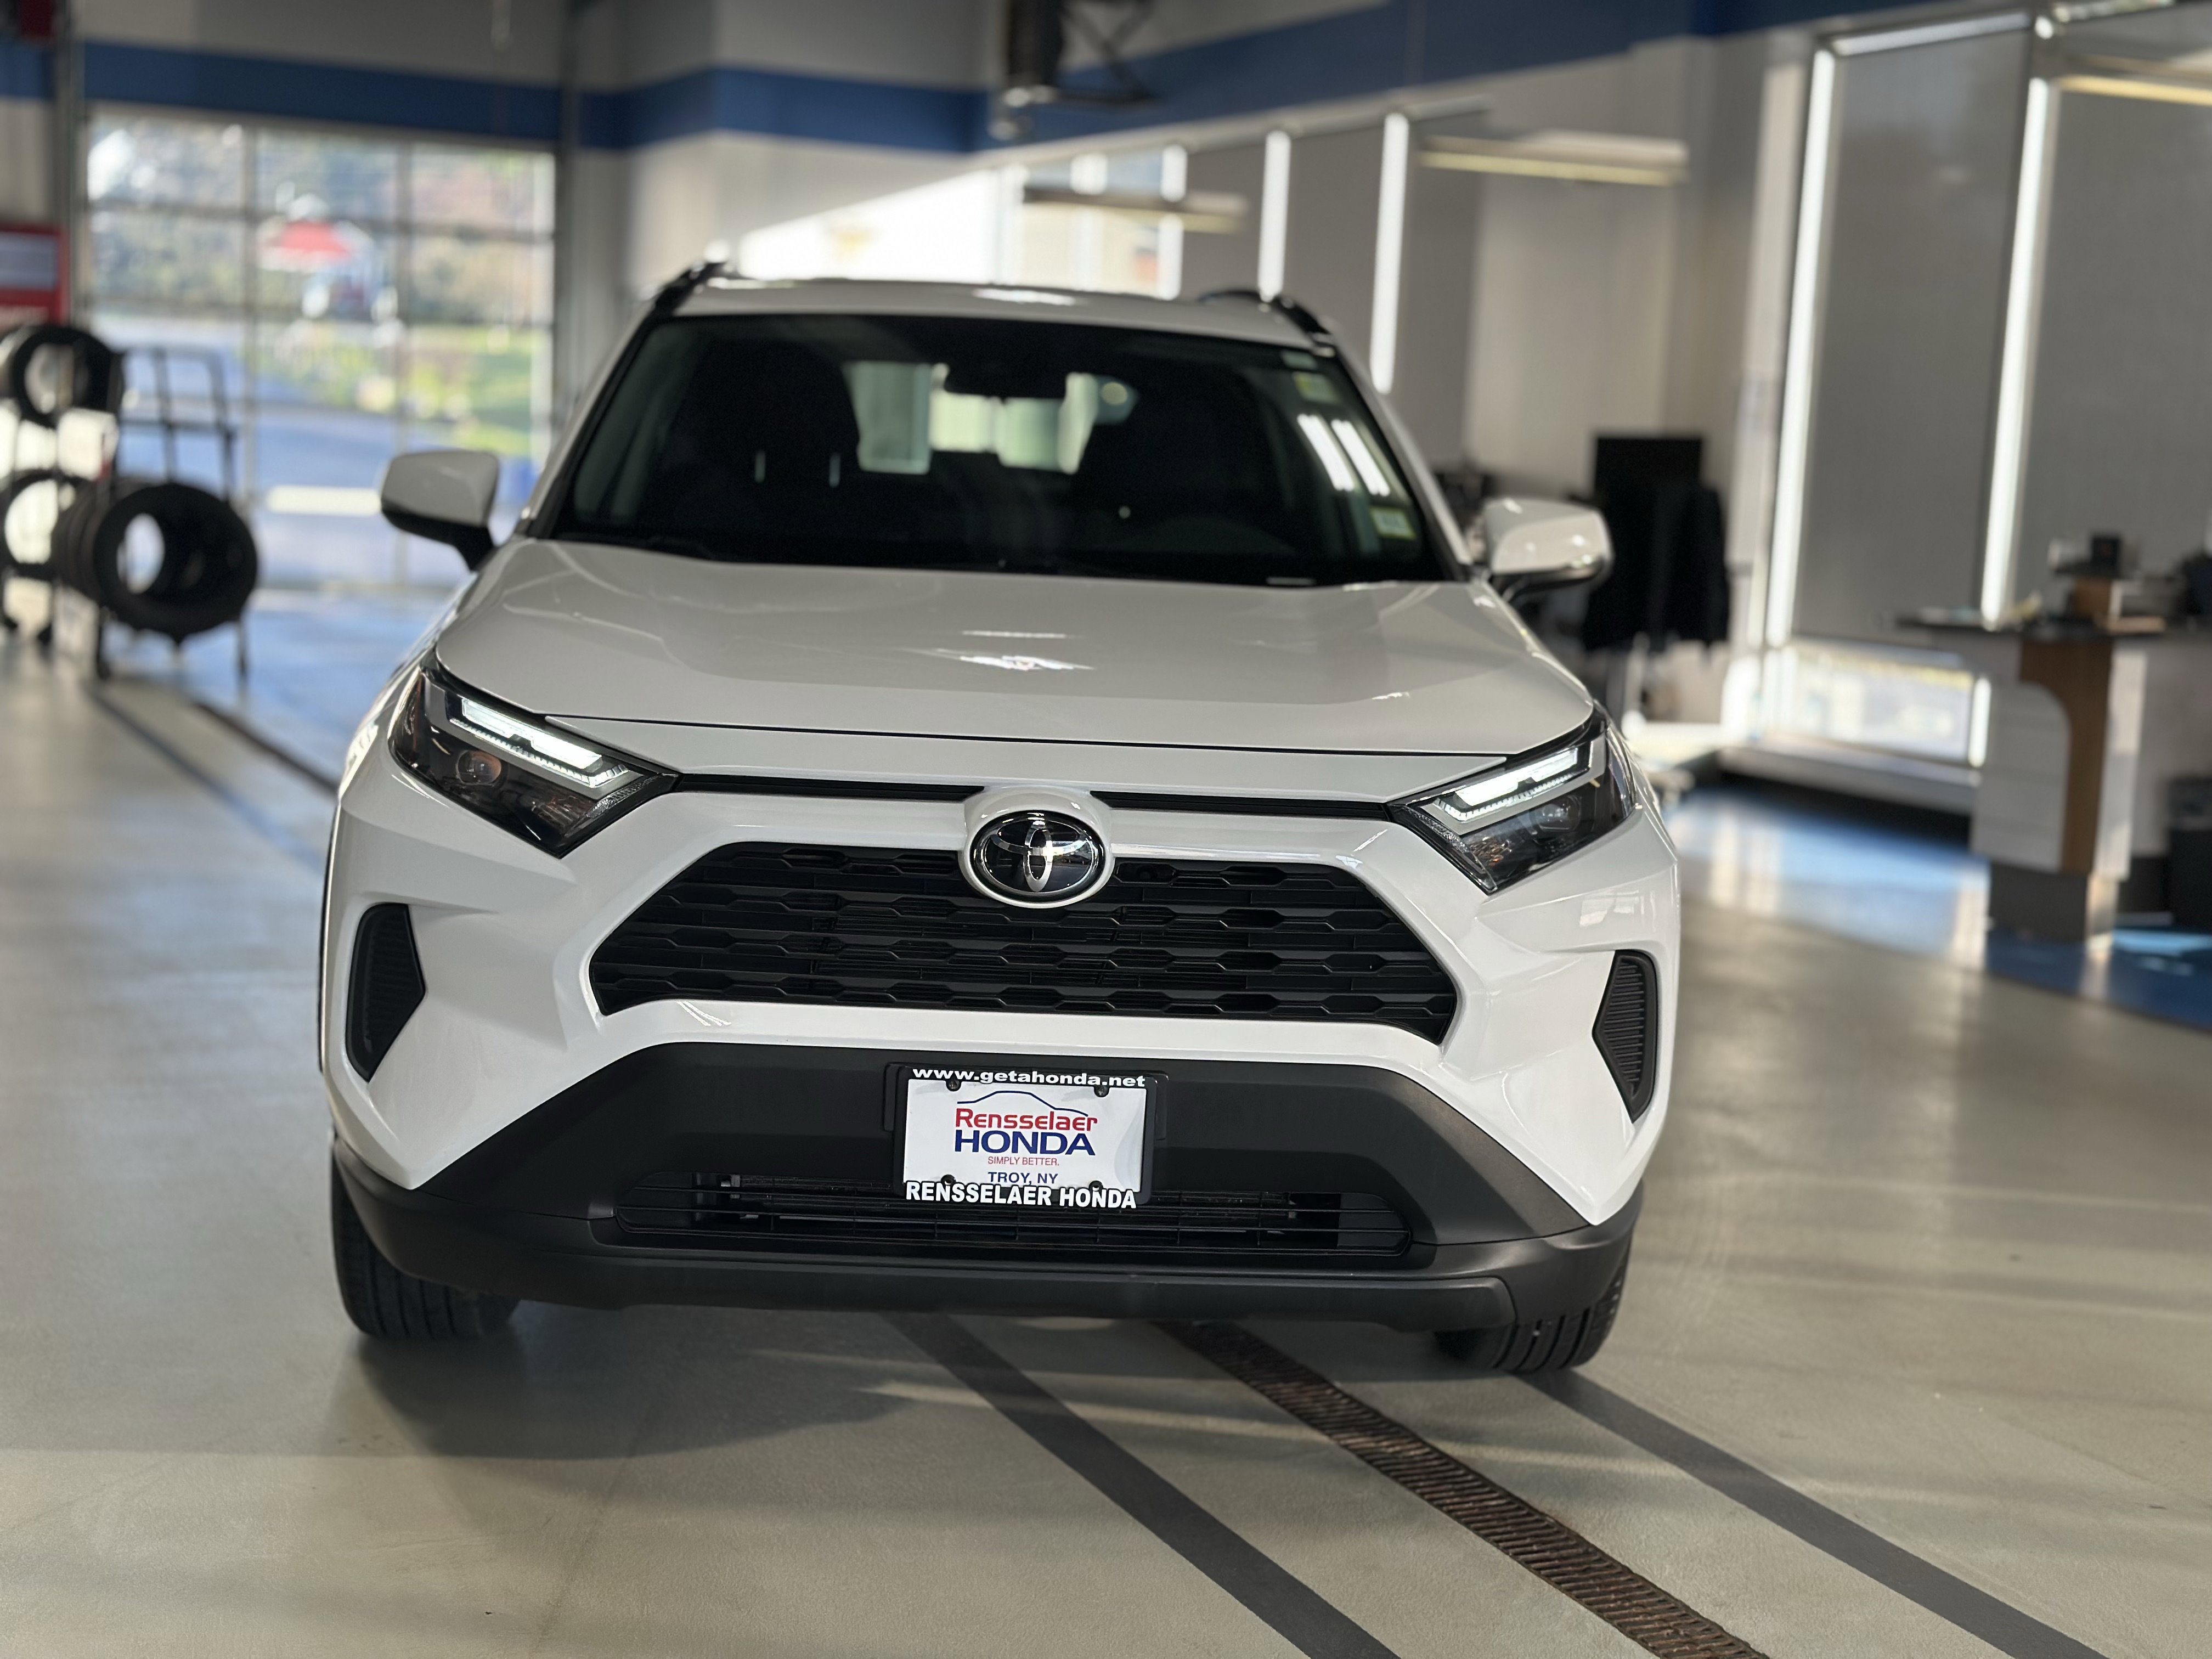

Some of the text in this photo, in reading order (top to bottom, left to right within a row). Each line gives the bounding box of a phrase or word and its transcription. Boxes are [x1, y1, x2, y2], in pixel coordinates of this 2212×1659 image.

[913, 1069, 1146, 1087] www.getahonda.net
[956, 1108, 1098, 1132] Rensselaer
[955, 1129, 1096, 1156] HONDA
[988, 1155, 1060, 1166] SIMPLY BETTER.
[988, 1171, 1058, 1185] TROY, NY
[906, 1181, 1137, 1209] RENSSELAER HONDA
